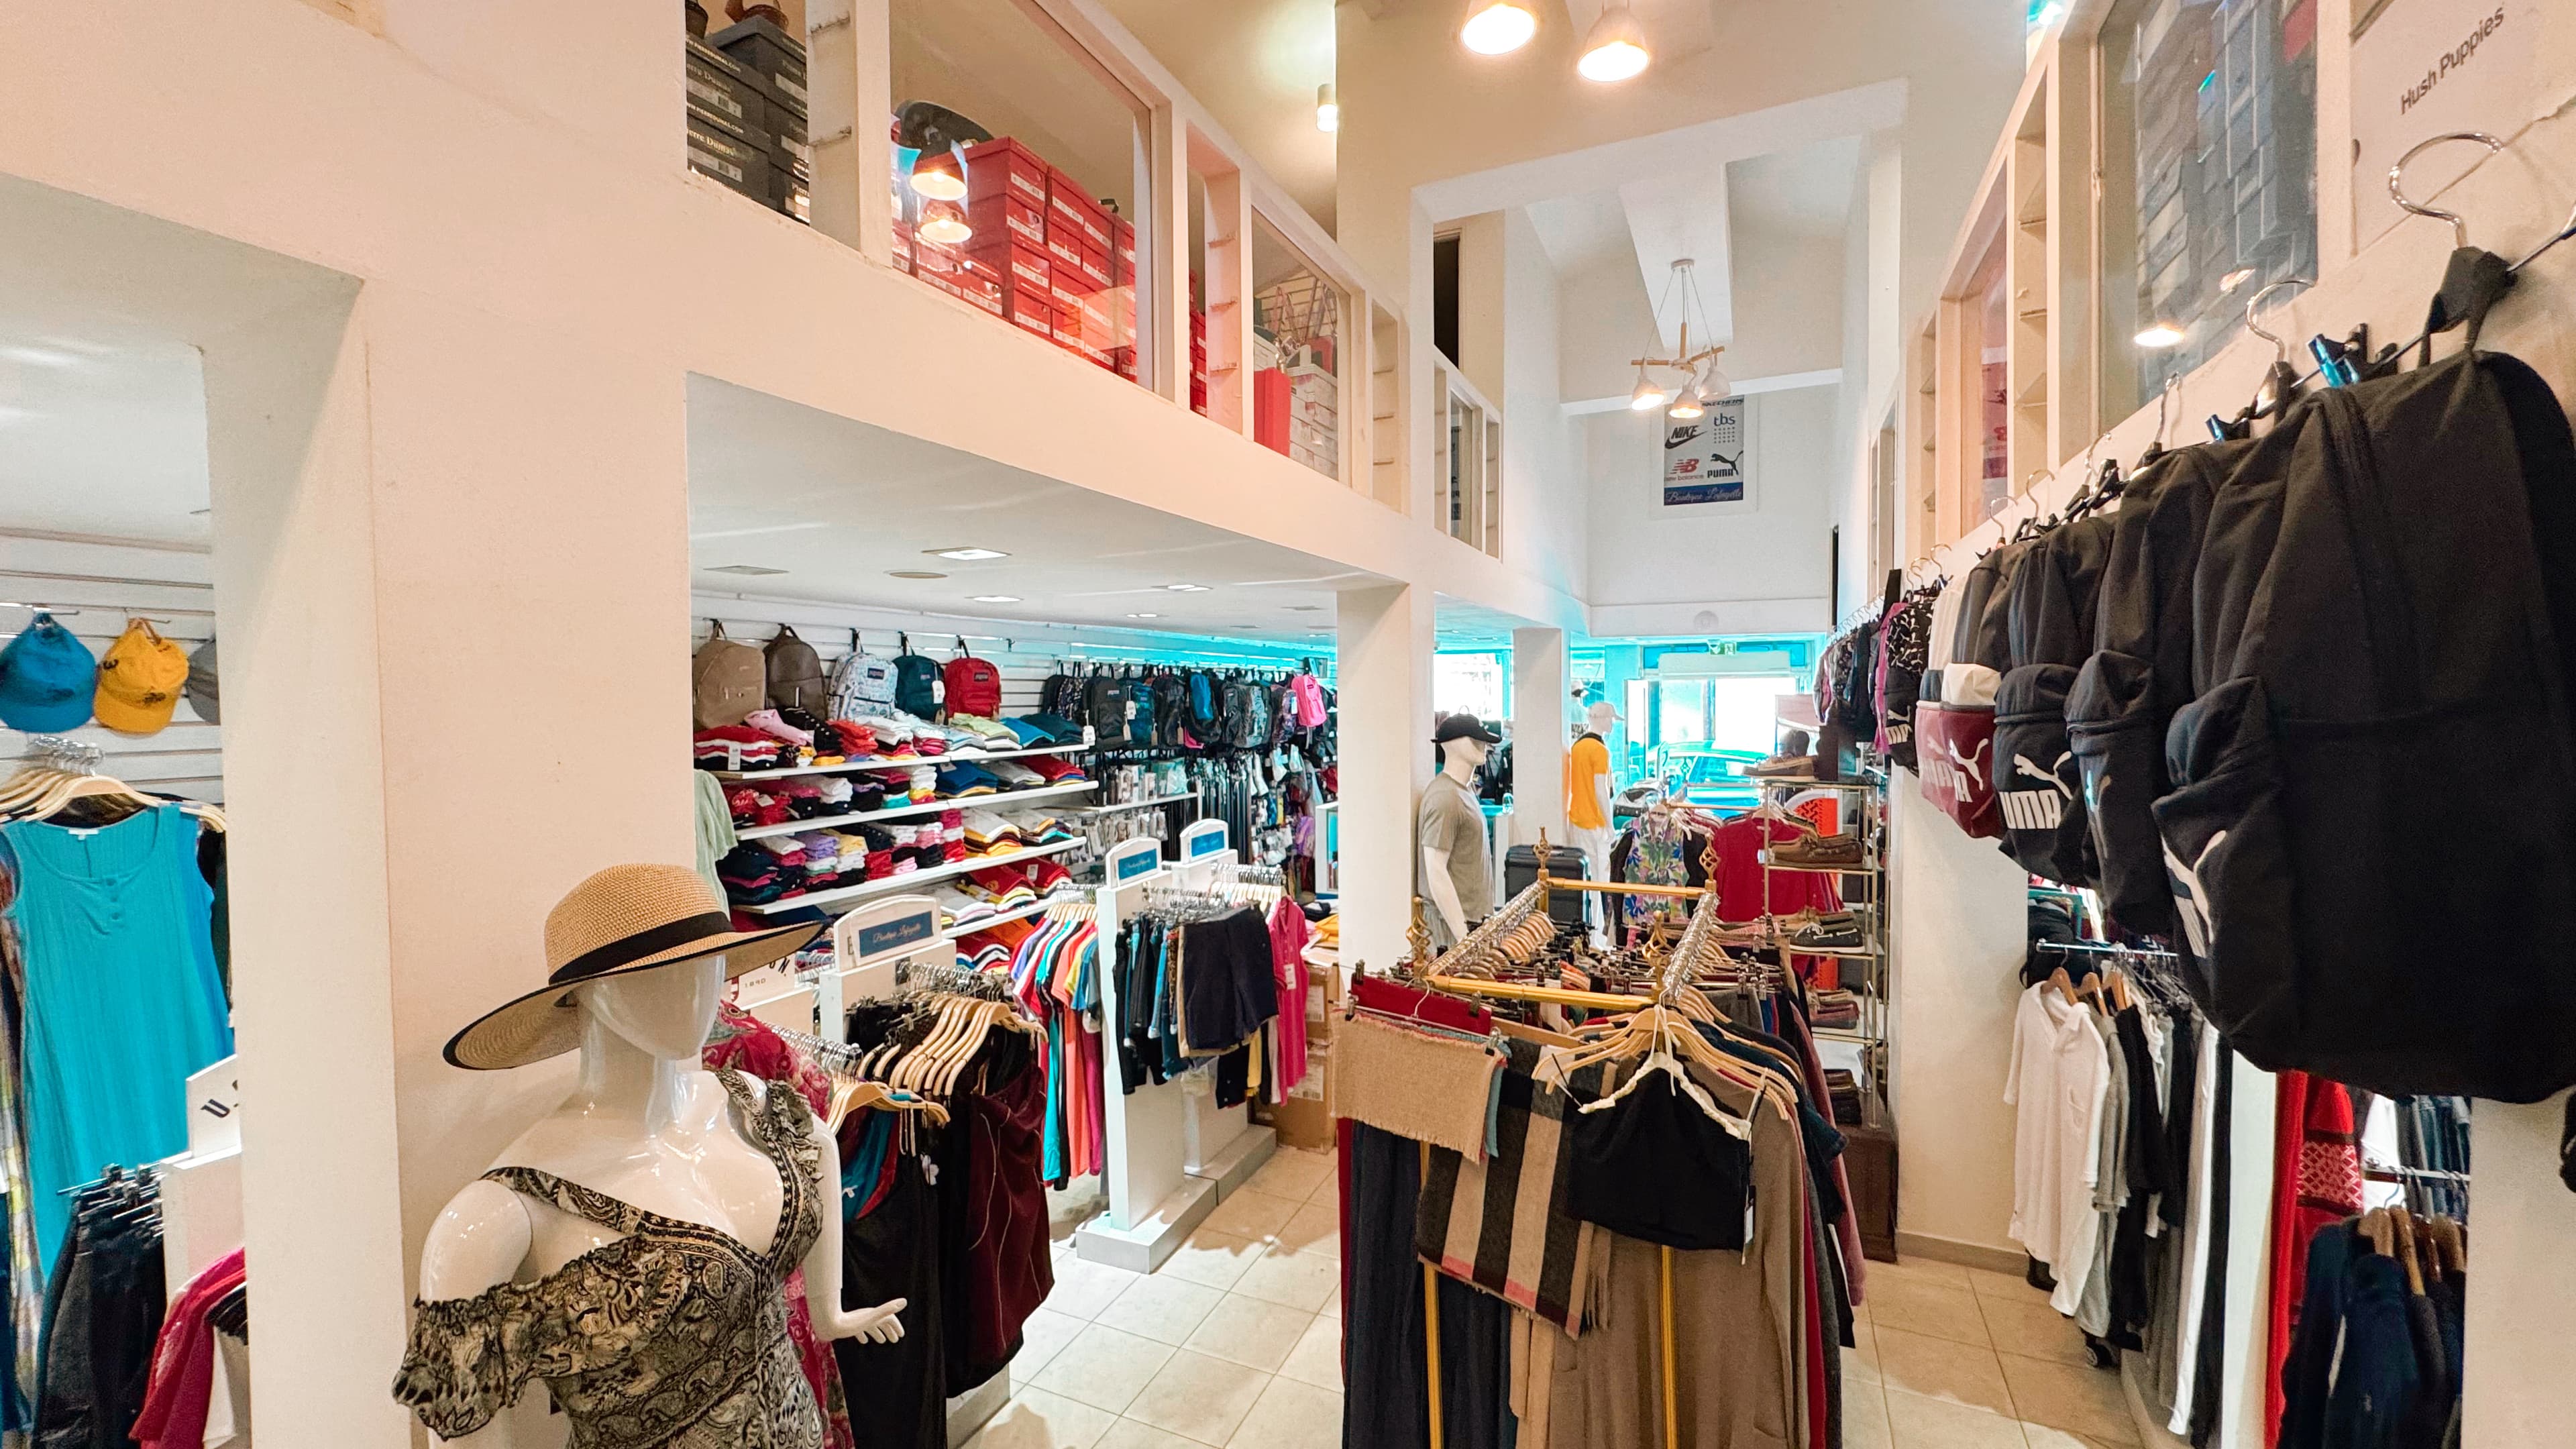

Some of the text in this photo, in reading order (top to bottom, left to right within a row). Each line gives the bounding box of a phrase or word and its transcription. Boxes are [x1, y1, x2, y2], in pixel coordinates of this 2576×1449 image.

[2400, 7, 2504, 115] Hush Puppies
[1713, 413, 1735, 427] tbs
[1670, 425, 1701, 440] NIKE
[1707, 468, 1734, 478] PUMA
[1999, 789, 2061, 830] UMA
